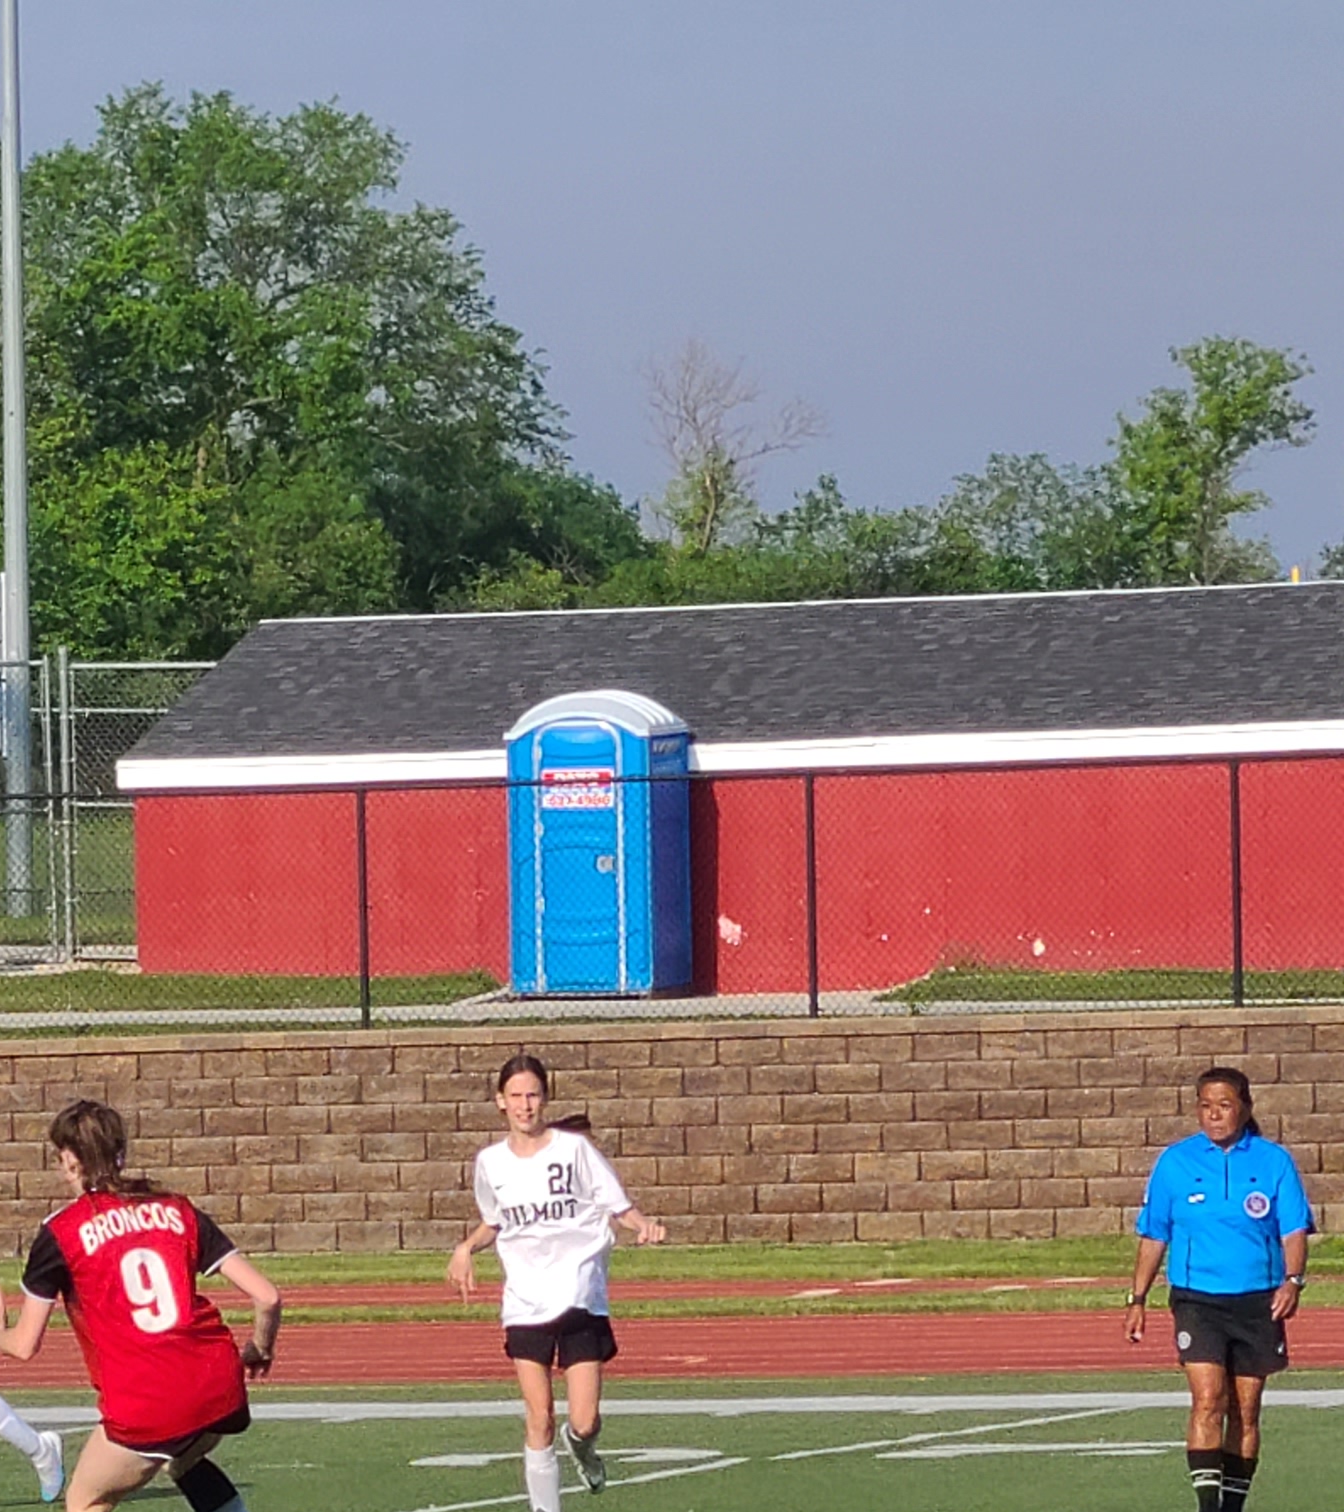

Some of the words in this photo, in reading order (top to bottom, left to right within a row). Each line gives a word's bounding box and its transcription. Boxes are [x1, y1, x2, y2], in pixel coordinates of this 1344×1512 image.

[547, 1162, 573, 1195] 21
[78, 1202, 185, 1256] BRONCOS
[119, 1247, 179, 1334] 9
